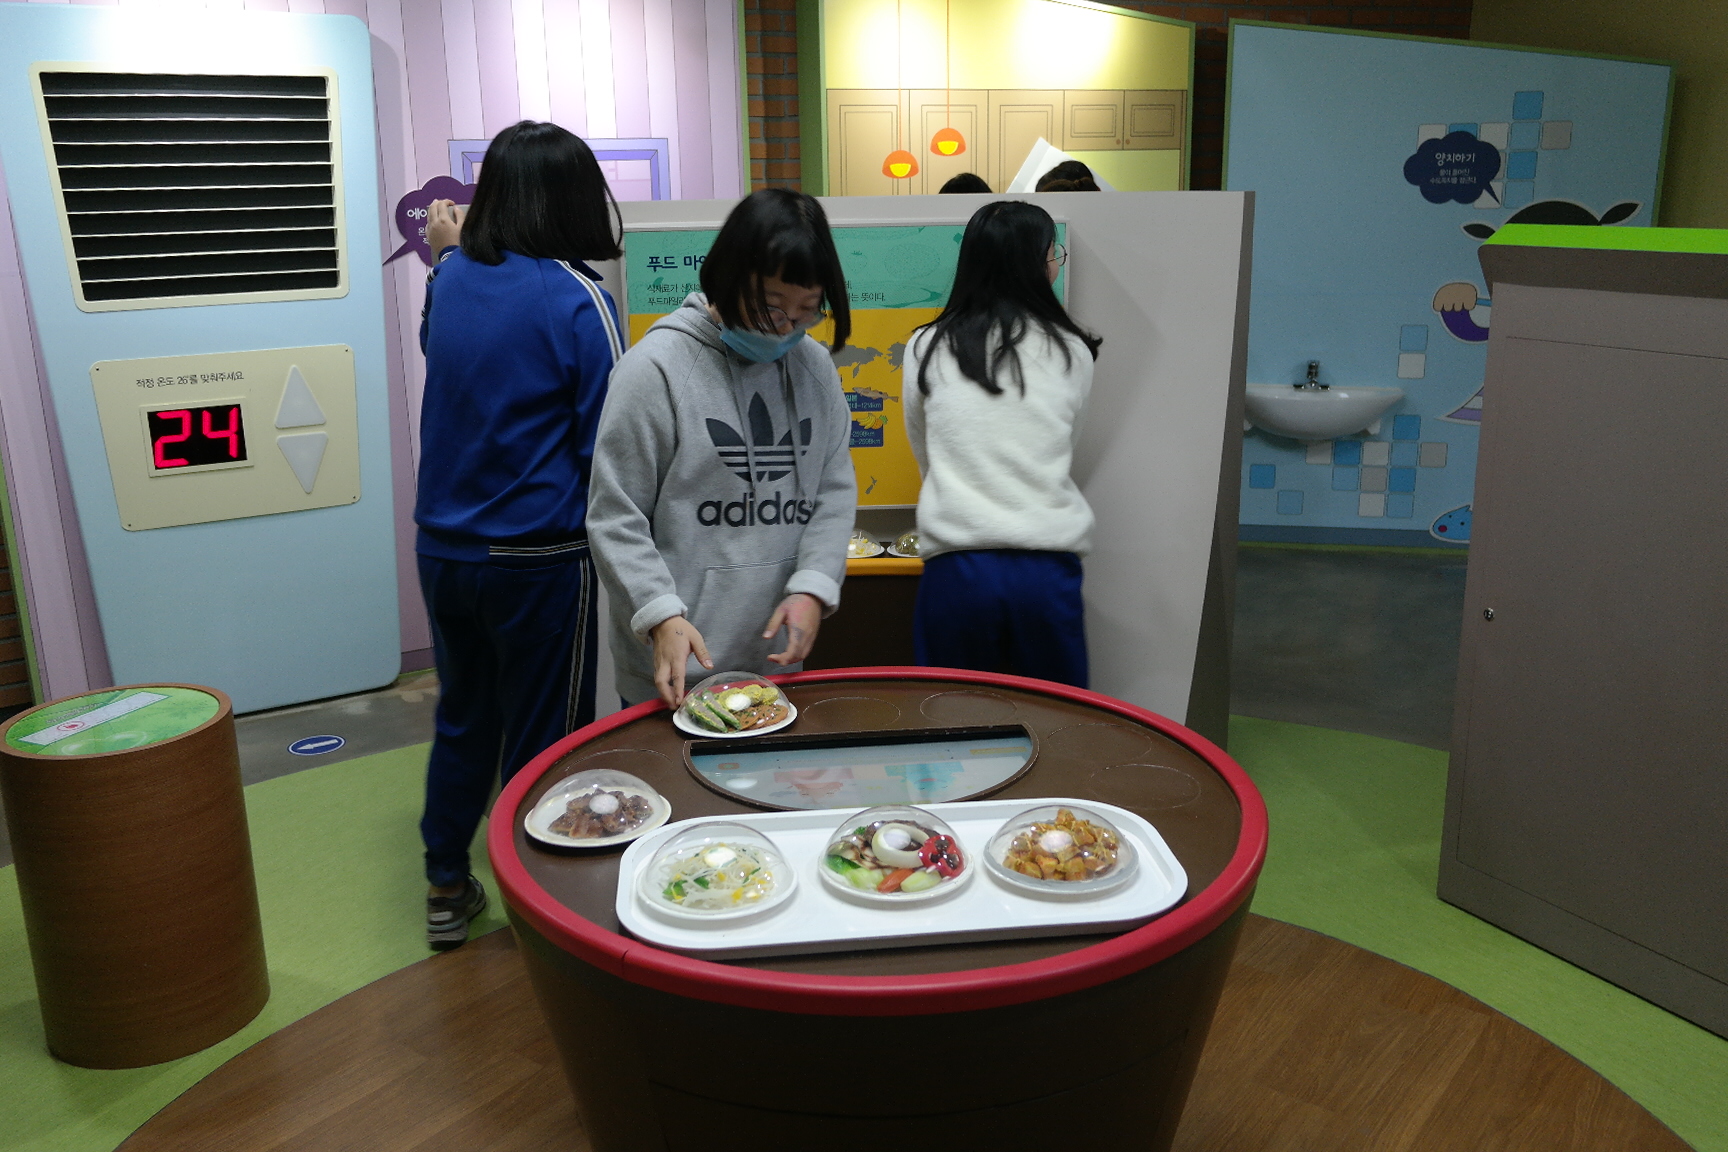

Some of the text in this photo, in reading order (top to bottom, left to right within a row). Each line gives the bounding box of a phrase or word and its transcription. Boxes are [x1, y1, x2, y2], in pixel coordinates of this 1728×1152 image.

[646, 256, 679, 273] 푸드
[647, 283, 678, 293] 식재료가
[136, 378, 155, 389] 적정
[157, 376, 175, 388] 온도
[200, 371, 244, 384] 맞춰주세요
[154, 407, 240, 469] 24
[697, 491, 813, 528] adidas
